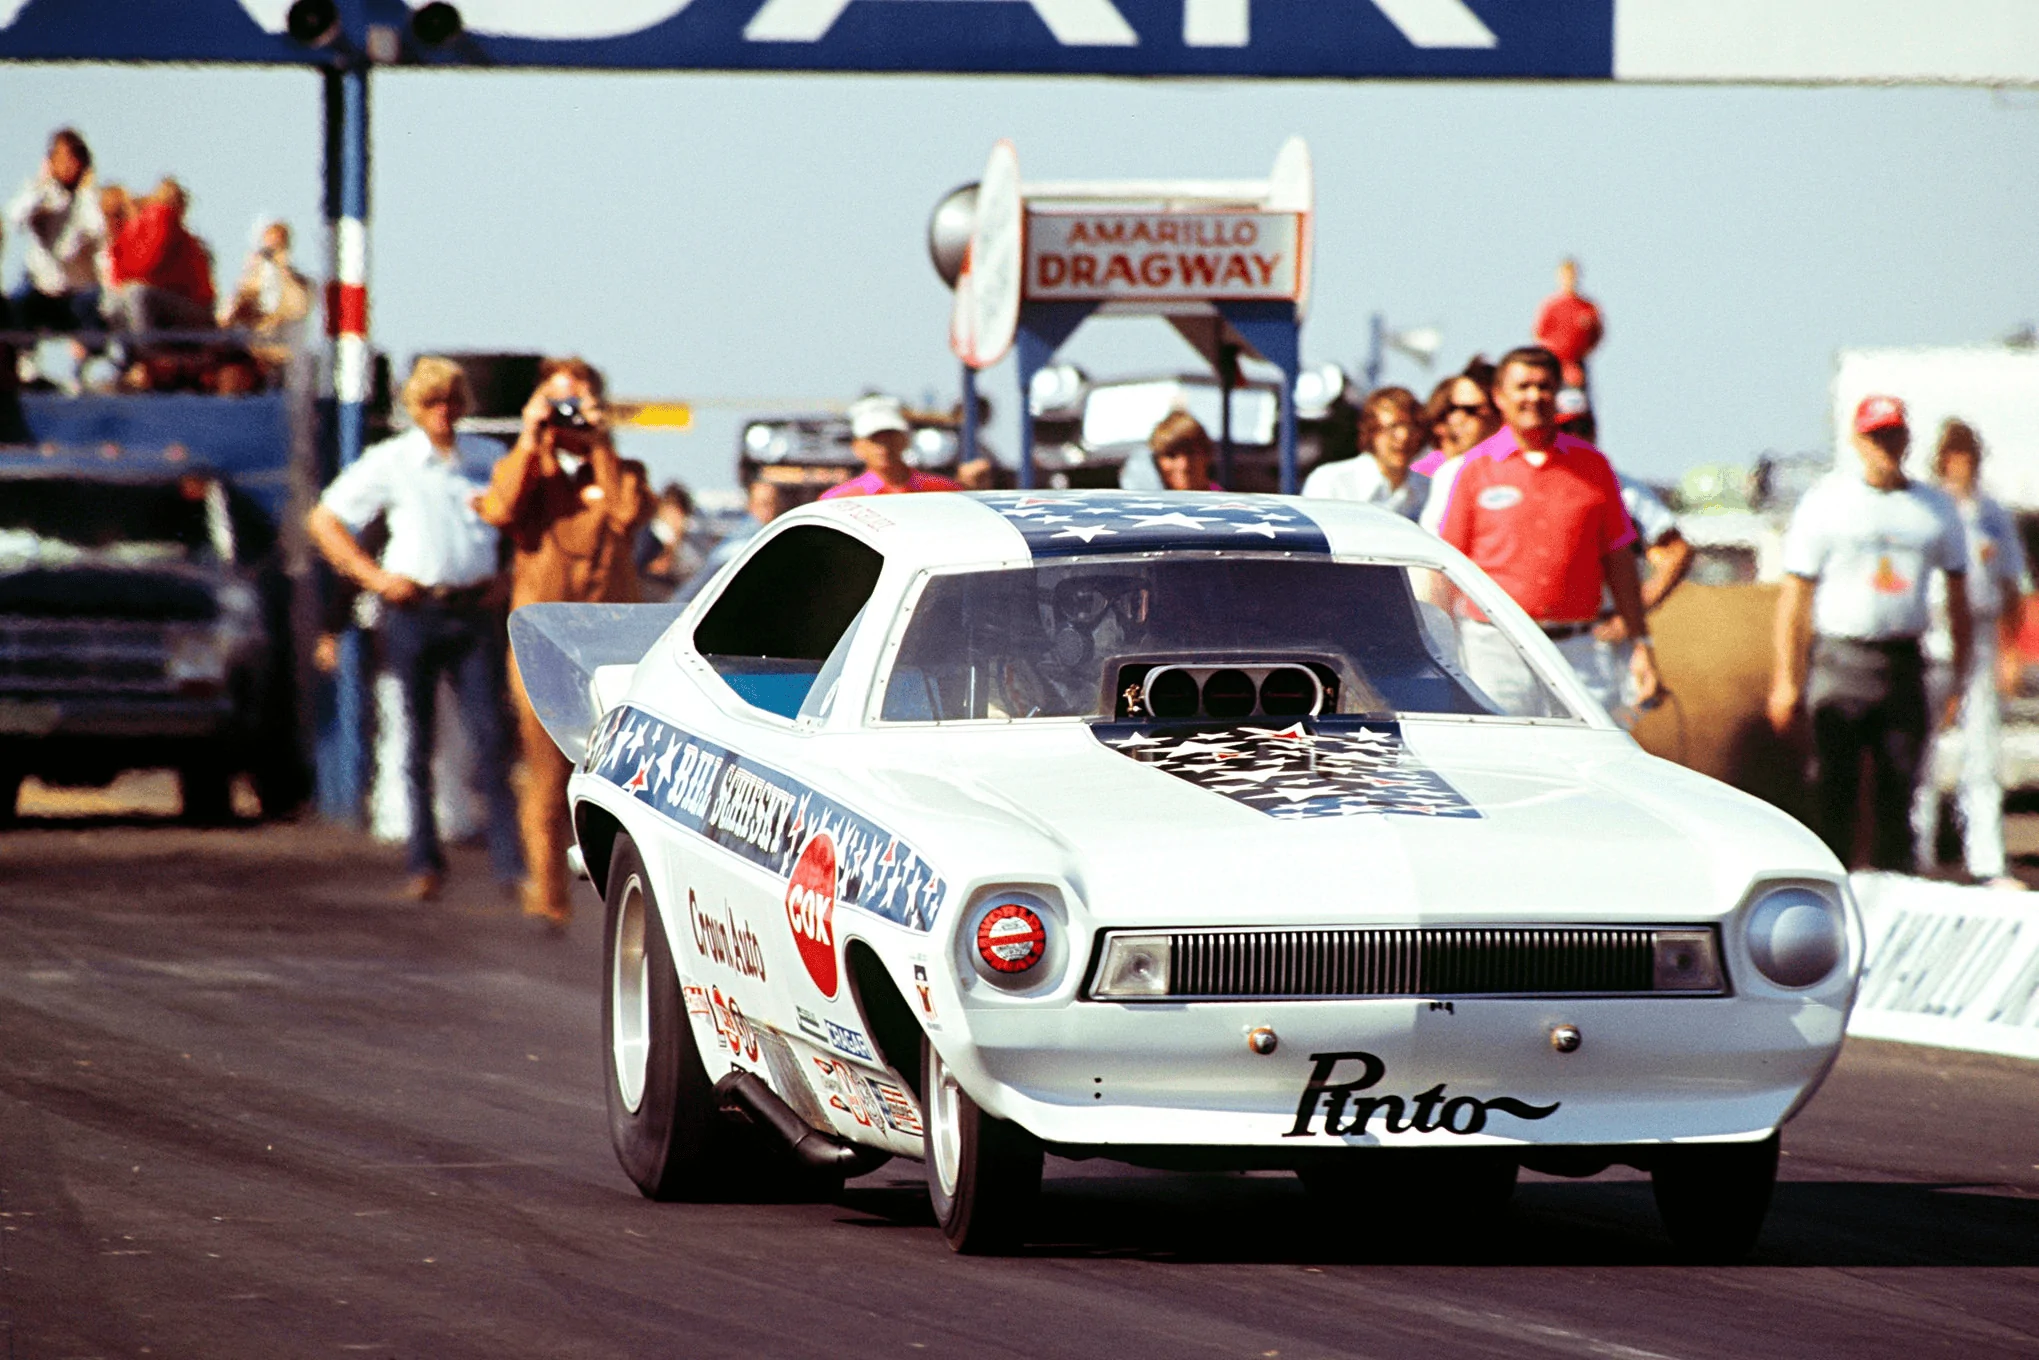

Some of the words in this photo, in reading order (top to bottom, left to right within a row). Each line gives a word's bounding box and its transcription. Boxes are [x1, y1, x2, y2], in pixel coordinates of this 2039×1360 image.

[1067, 220, 1258, 247] AMARILLO
[1037, 253, 1282, 288] DRAGWAY
[666, 742, 724, 820] BILL
[689, 886, 735, 969] Crown
[725, 897, 766, 983] Auto
[788, 883, 832, 947] COX
[1282, 1051, 1562, 1139] Pinto
